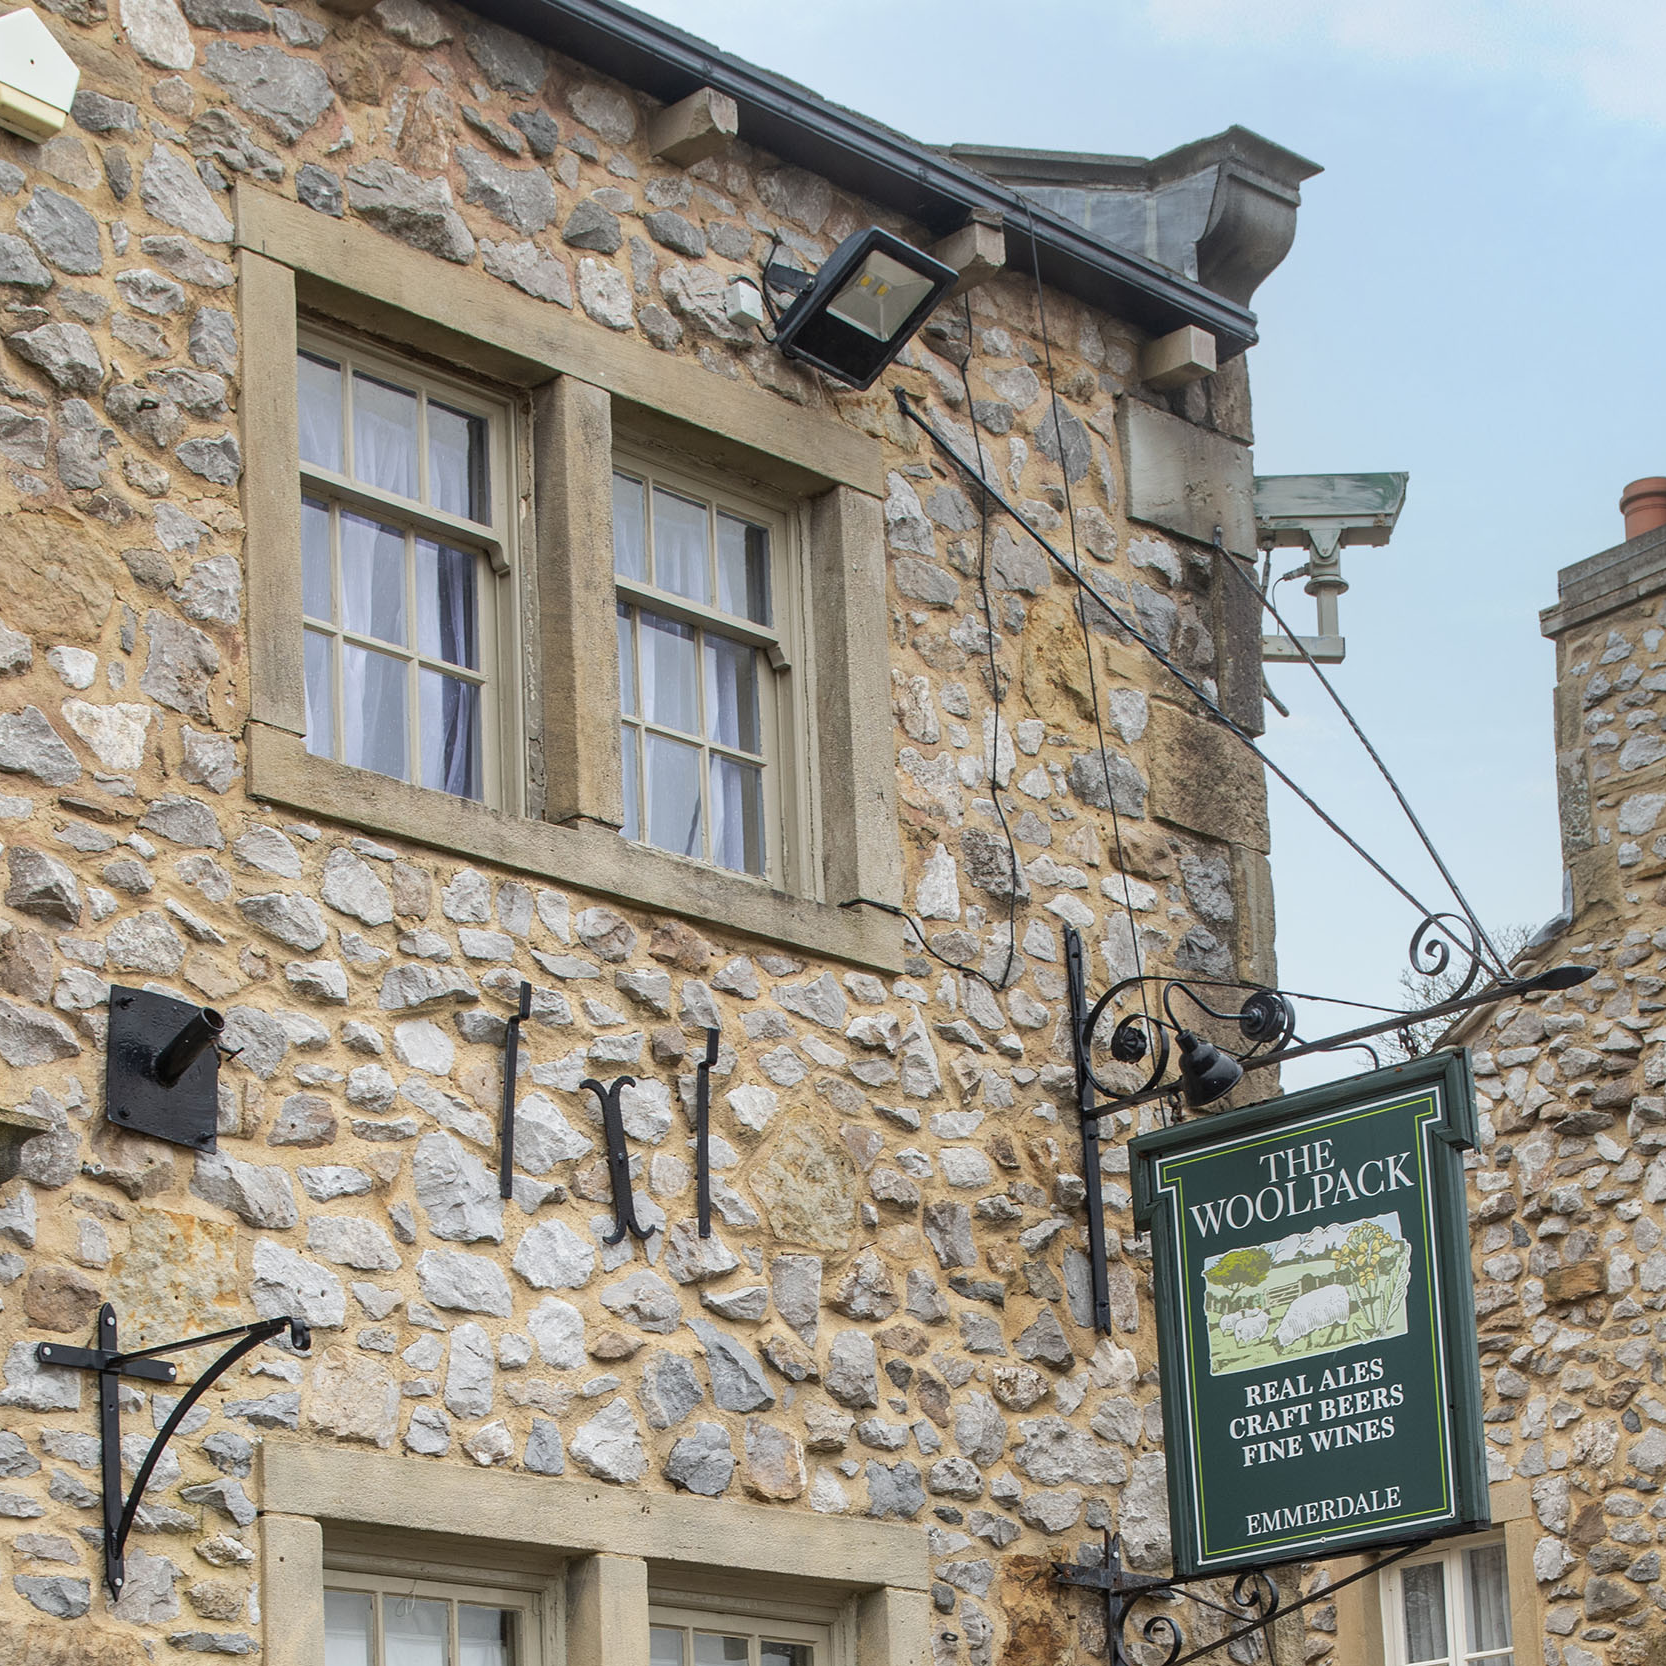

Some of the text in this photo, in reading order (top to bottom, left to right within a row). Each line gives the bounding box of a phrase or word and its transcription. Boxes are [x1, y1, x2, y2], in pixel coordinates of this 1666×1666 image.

[1259, 1138, 1336, 1183] THE
[1188, 1151, 1415, 1238] WOOLPACK
[1244, 1357, 1384, 1408] REAL ALES
[1229, 1383, 1404, 1440] CRAFT BEERS
[1242, 1415, 1395, 1467] FINE WINES
[1246, 1486, 1402, 1536] EMMERDALE
